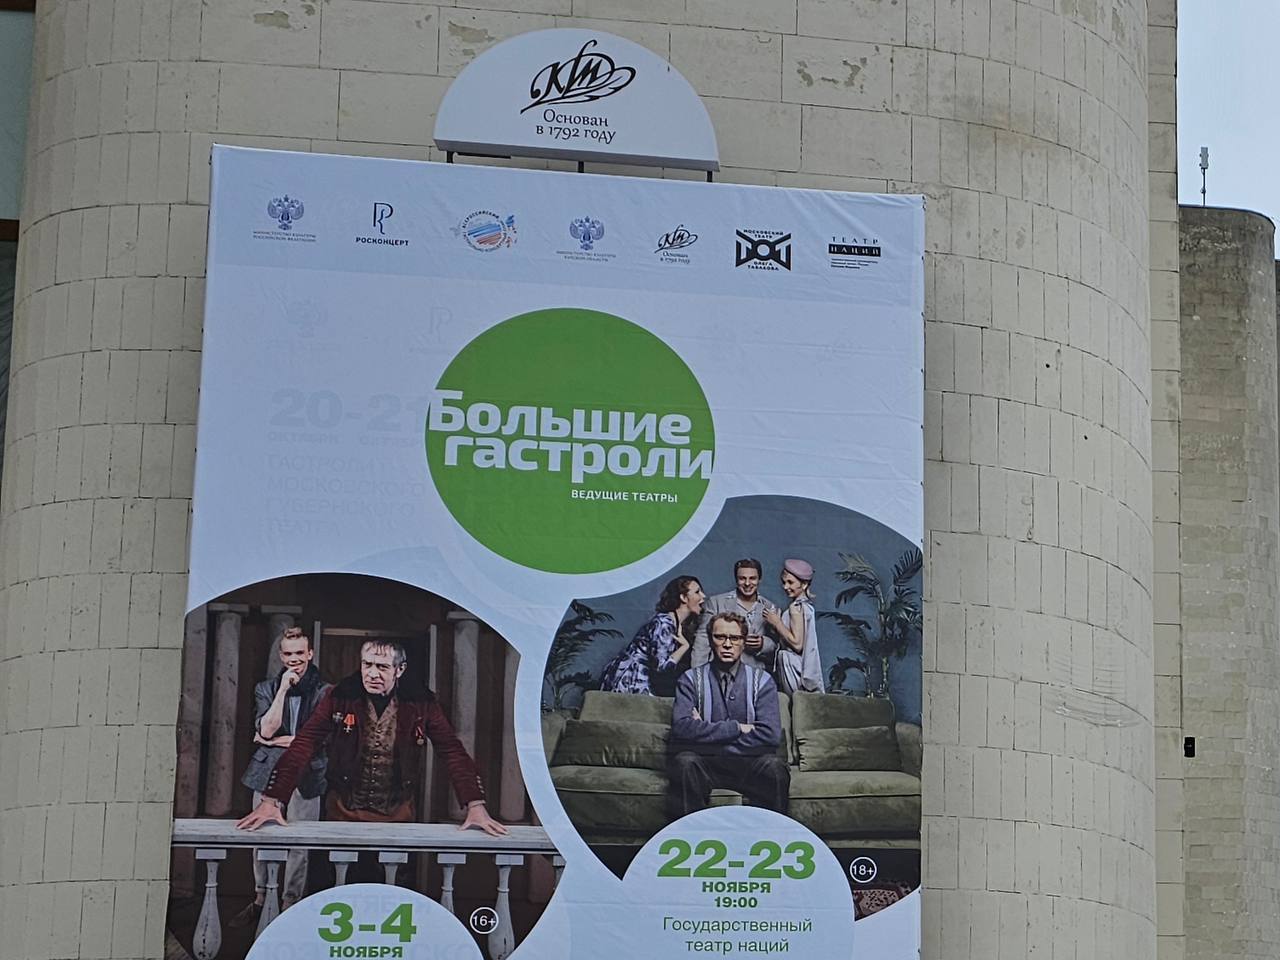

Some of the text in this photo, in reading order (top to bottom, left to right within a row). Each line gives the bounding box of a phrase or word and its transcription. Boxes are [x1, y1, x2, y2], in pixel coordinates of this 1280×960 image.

[543, 109, 608, 126] Основан
[549, 123, 579, 140] 1792
[584, 130, 616, 144] году
[356, 237, 409, 246] РОСКОНЦЕРТ
[429, 388, 693, 445] Большие
[444, 435, 714, 483] гастроли
[571, 490, 679, 503] ВЕДУЩИЕ ТЕАТРЫ
[657, 839, 816, 880] 22-23
[852, 864, 874, 877] 18+
[702, 882, 770, 893] НОЯБРЯ
[715, 897, 757, 908] 19:00
[318, 902, 416, 942] 3-4
[472, 914, 496, 928] 16+
[664, 917, 811, 934] Государственный
[330, 946, 402, 958] НОЯБРЯ
[686, 939, 788, 955] театр наций
